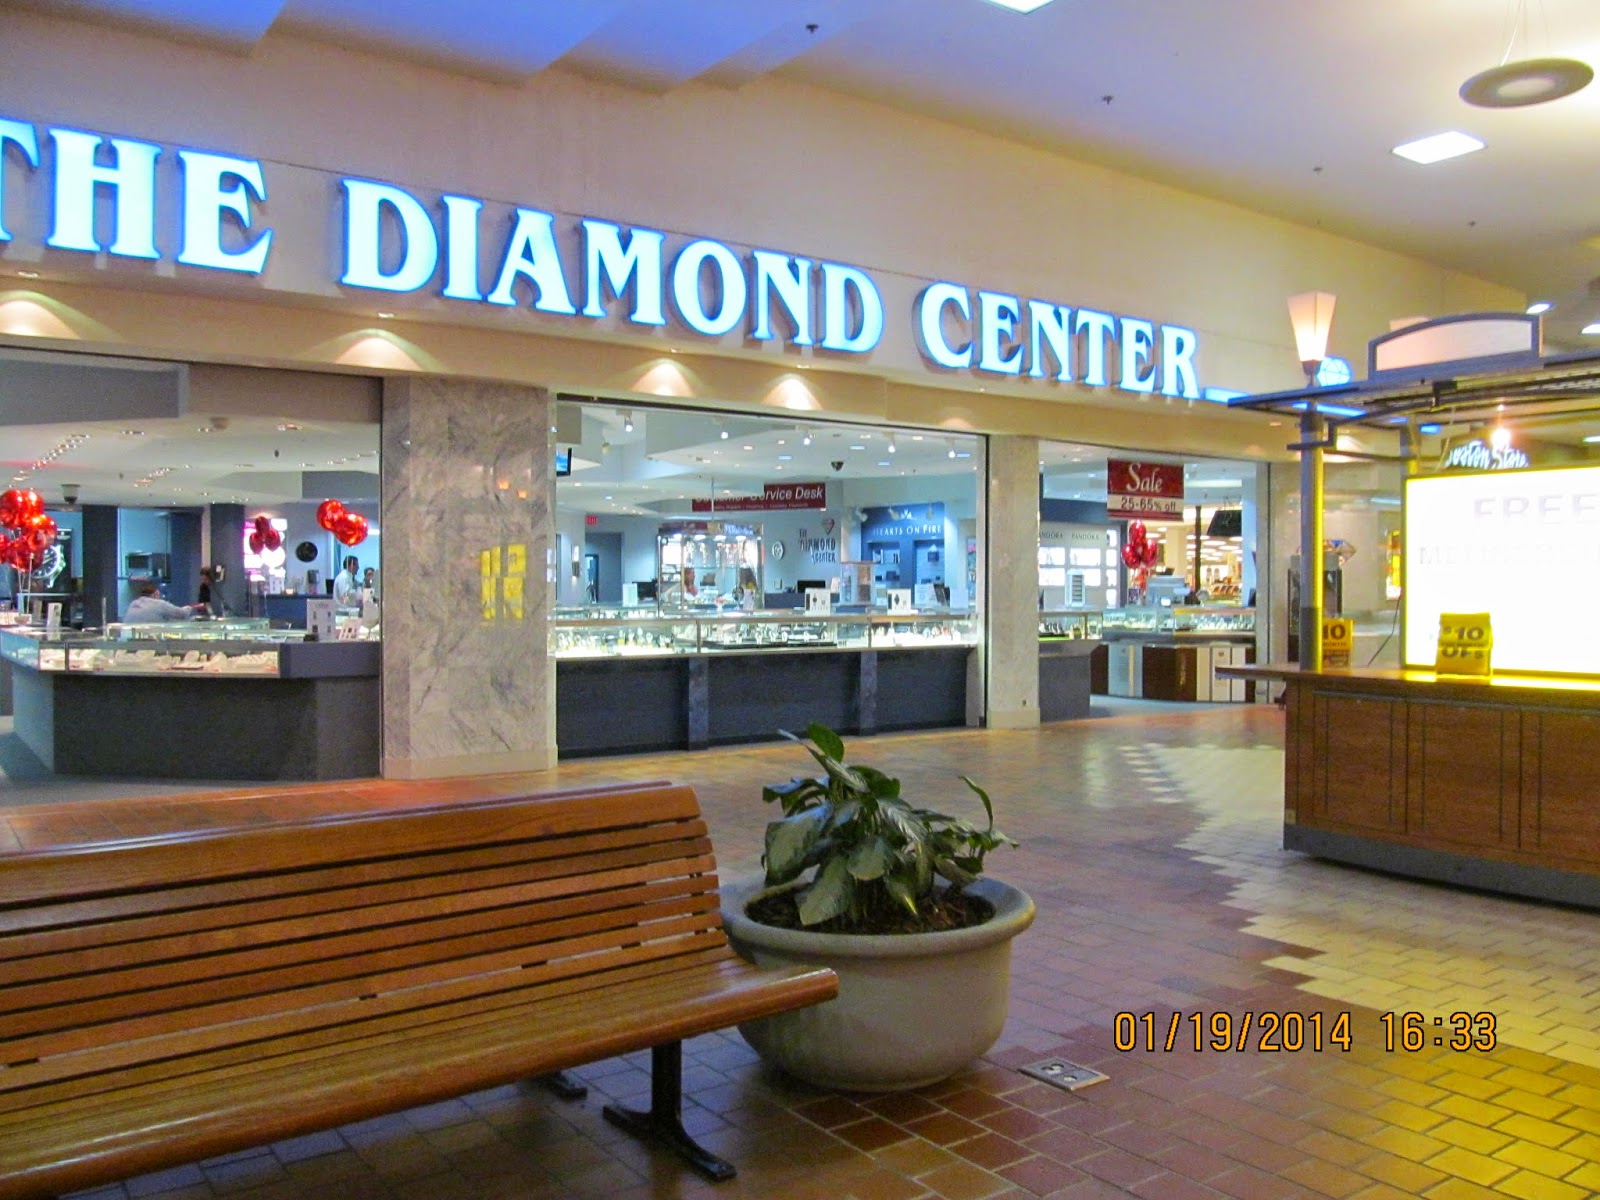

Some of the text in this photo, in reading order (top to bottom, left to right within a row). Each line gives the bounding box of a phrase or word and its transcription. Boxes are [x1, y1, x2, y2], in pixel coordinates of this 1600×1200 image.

[340, 177, 884, 354] DIAMOND
[919, 280, 1202, 401] CENTER
[1126, 462, 1163, 493] Sale
[795, 486, 823, 499] Desk
[1121, 496, 1176, 512] 25-65% off
[873, 523, 941, 536] HEARTS ON FIRE
[1039, 531, 1063, 539] NDORA
